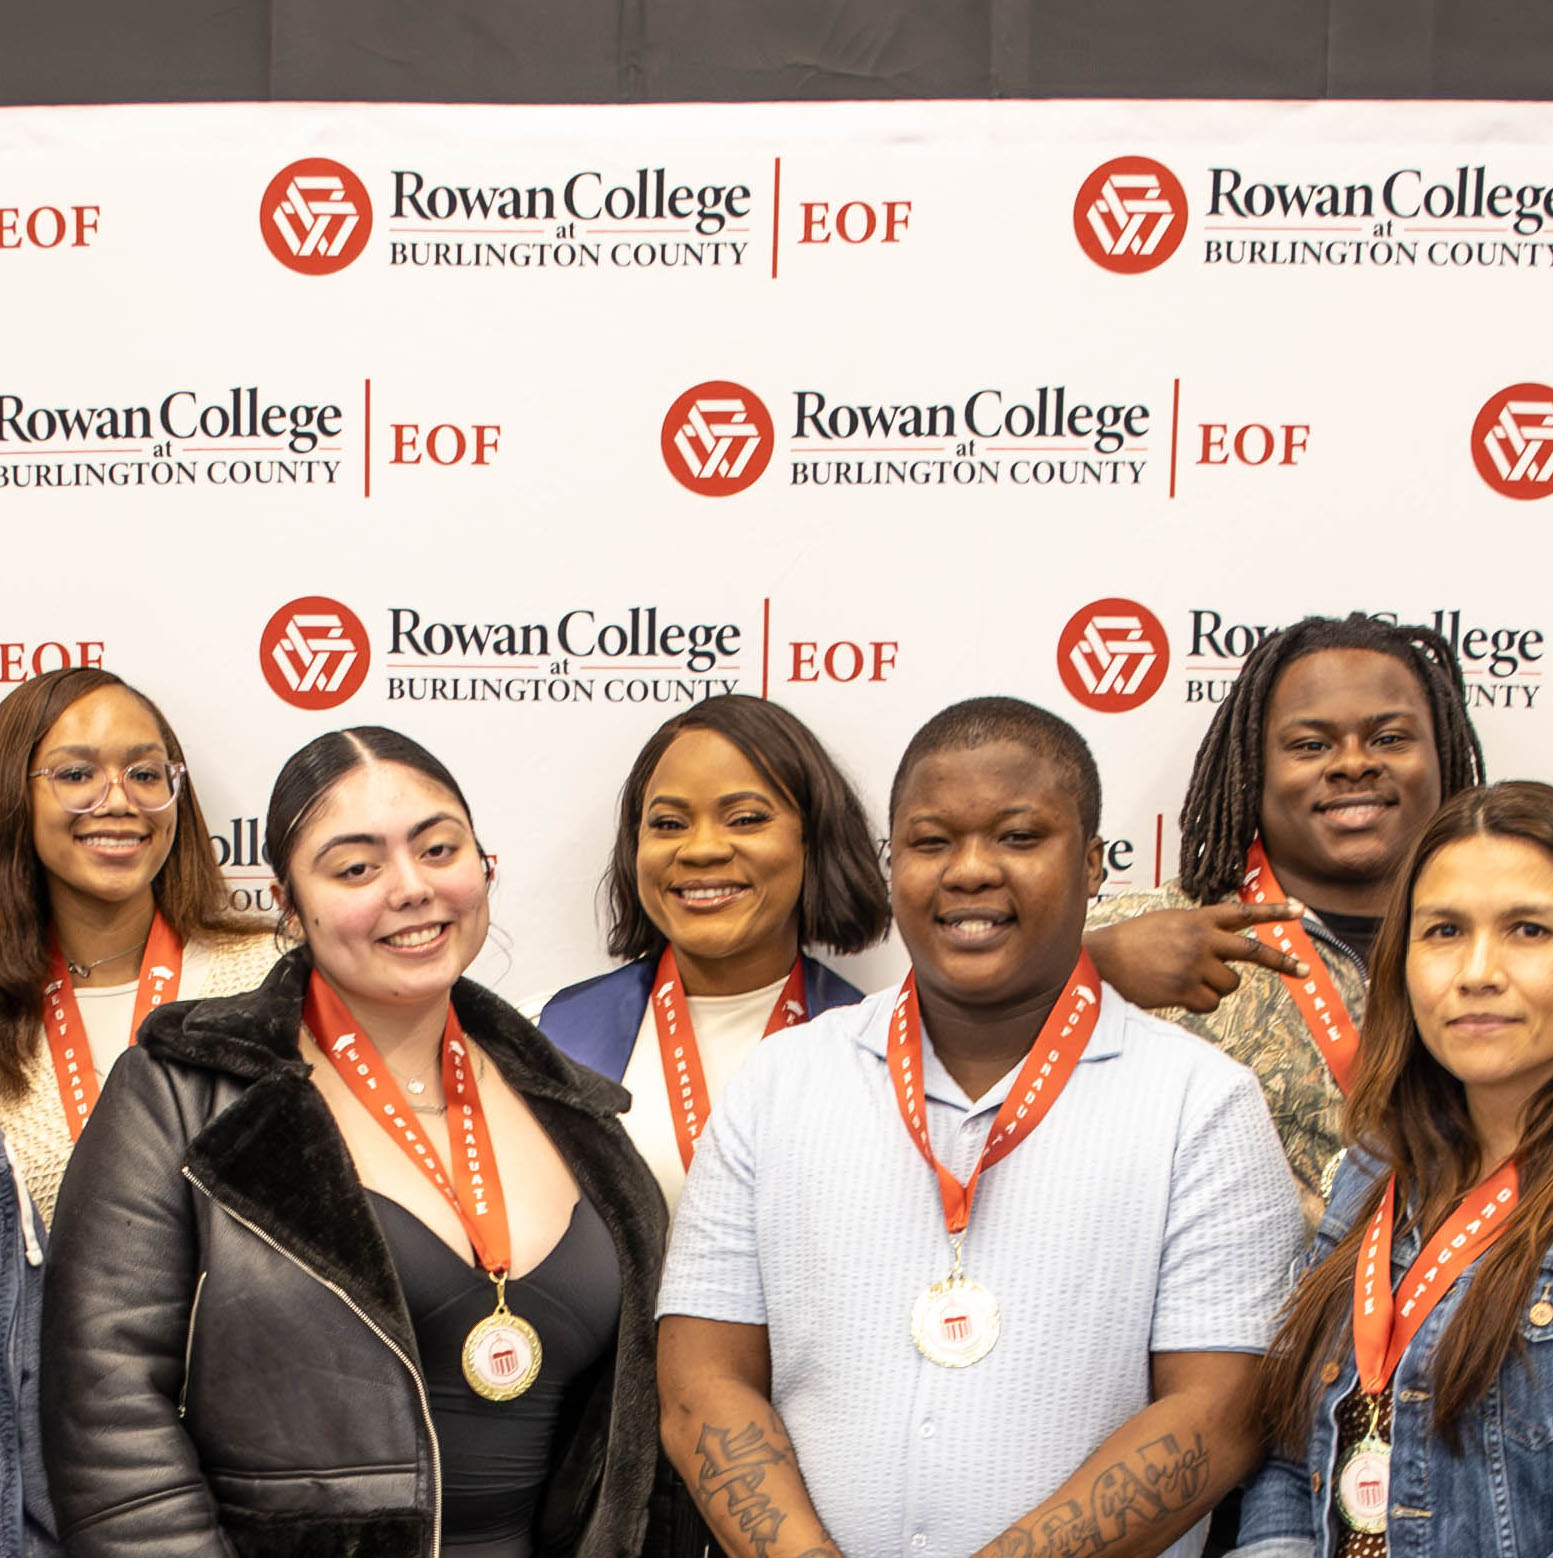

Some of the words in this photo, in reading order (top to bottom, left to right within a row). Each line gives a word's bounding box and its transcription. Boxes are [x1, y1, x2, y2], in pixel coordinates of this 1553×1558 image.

[391, 172, 554, 219] Rowan
[562, 169, 750, 237] College
[1208, 169, 1372, 217] Rowan
[555, 222, 575, 239] at
[800, 201, 911, 244] EOF
[1373, 220, 1393, 237] at
[391, 243, 600, 265] BURLINGTON
[612, 243, 747, 266] COUNTY
[1205, 241, 1417, 263] BURLINGTON
[159, 388, 341, 456] College
[793, 392, 954, 439] Rowan
[962, 387, 1149, 455] College
[153, 441, 172, 458] at
[391, 424, 500, 465] EOF
[955, 439, 975, 456] at
[1197, 424, 1309, 465] EOF
[208, 462, 340, 483] COUNTY
[792, 462, 999, 484] BURLINGTON
[1011, 462, 1146, 484] COUNTY
[388, 609, 548, 655] Rowan
[556, 608, 740, 674] College
[549, 659, 569, 675] at
[789, 642, 898, 682] EOF
[388, 679, 593, 700] BURLINGTON
[605, 680, 742, 705] COUNTY
[346, 1049, 378, 1091] EOF
[462, 1104, 489, 1217] GRADUATE
[1400, 1188, 1512, 1317] GRADUATE
